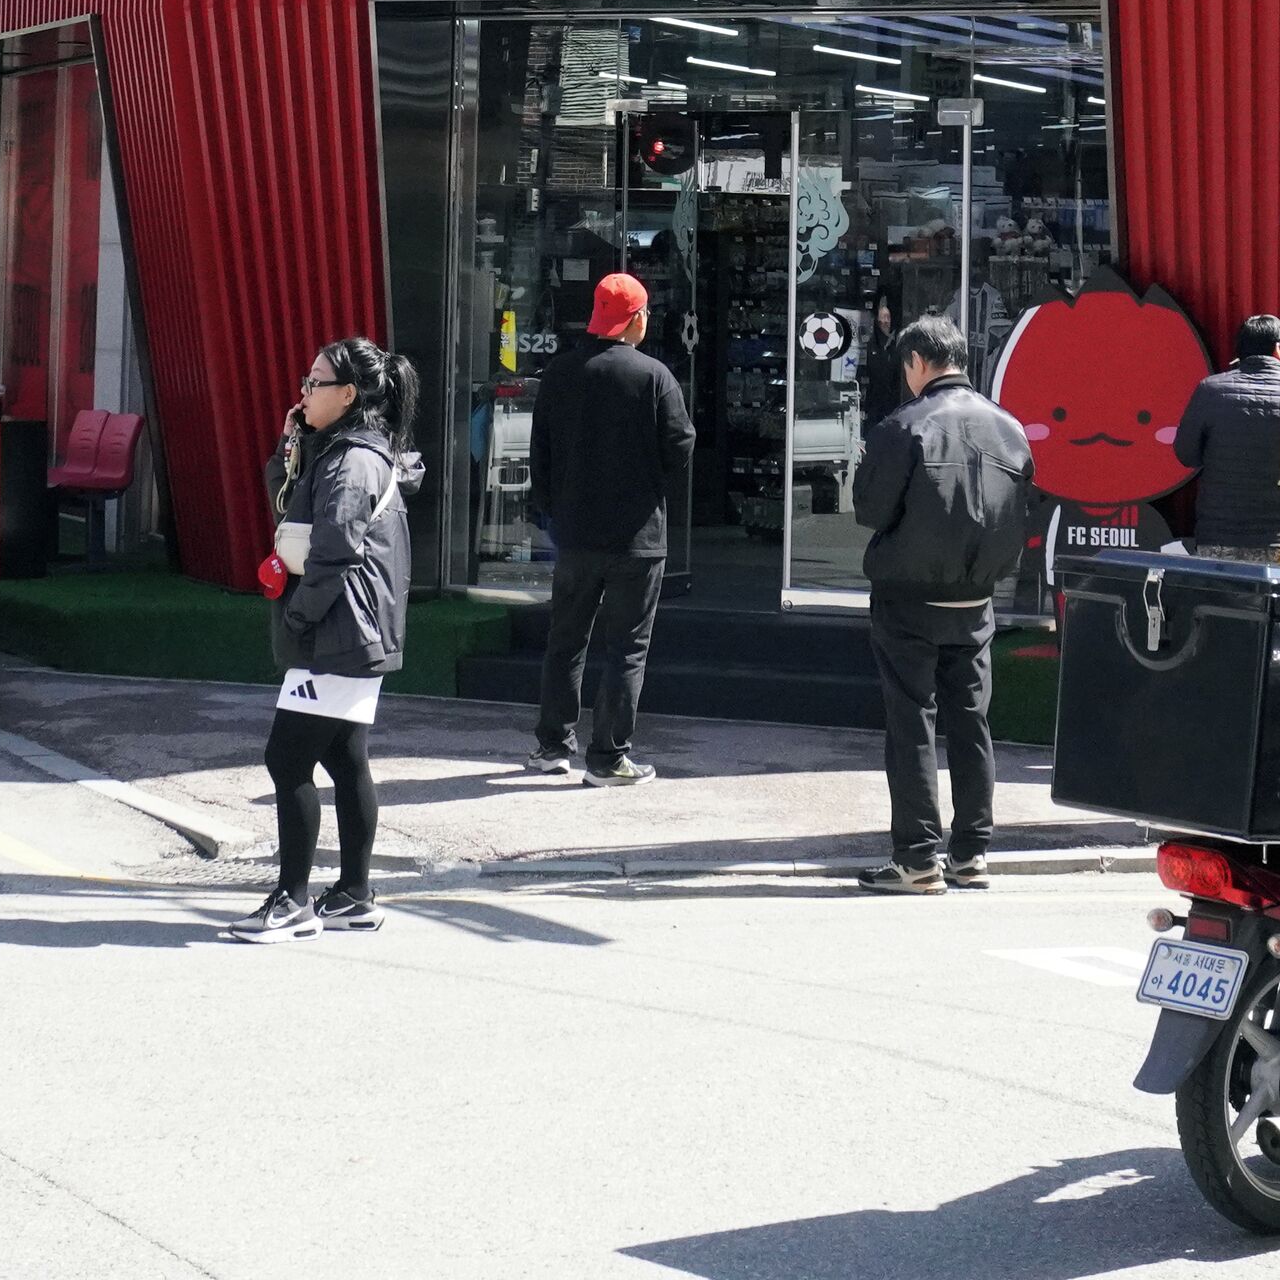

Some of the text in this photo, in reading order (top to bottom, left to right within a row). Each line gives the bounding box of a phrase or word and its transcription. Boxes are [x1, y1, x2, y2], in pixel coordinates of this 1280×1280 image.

[511, 333, 558, 354] S25
[1067, 526, 1139, 548] FC SEOUL
[1173, 953, 1225, 974] 서울 서대문
[1167, 970, 1230, 1004] 4045
